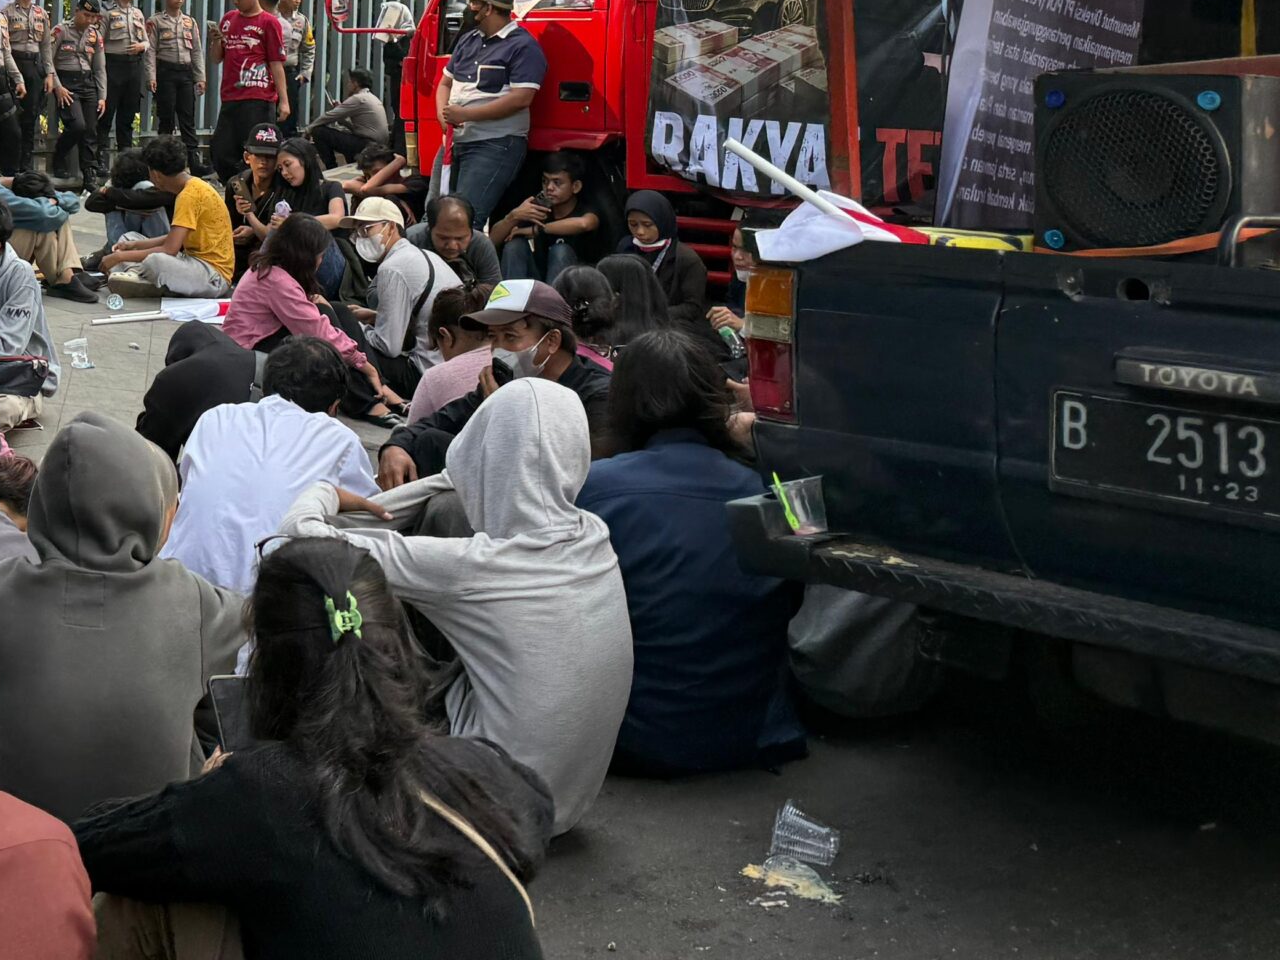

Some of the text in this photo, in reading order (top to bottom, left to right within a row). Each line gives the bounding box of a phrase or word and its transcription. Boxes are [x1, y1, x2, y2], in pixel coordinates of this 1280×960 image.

[651, 110, 833, 195] RAKYA
[1140, 364, 1259, 397] TOYOTA
[1063, 400, 1266, 478] B 2513
